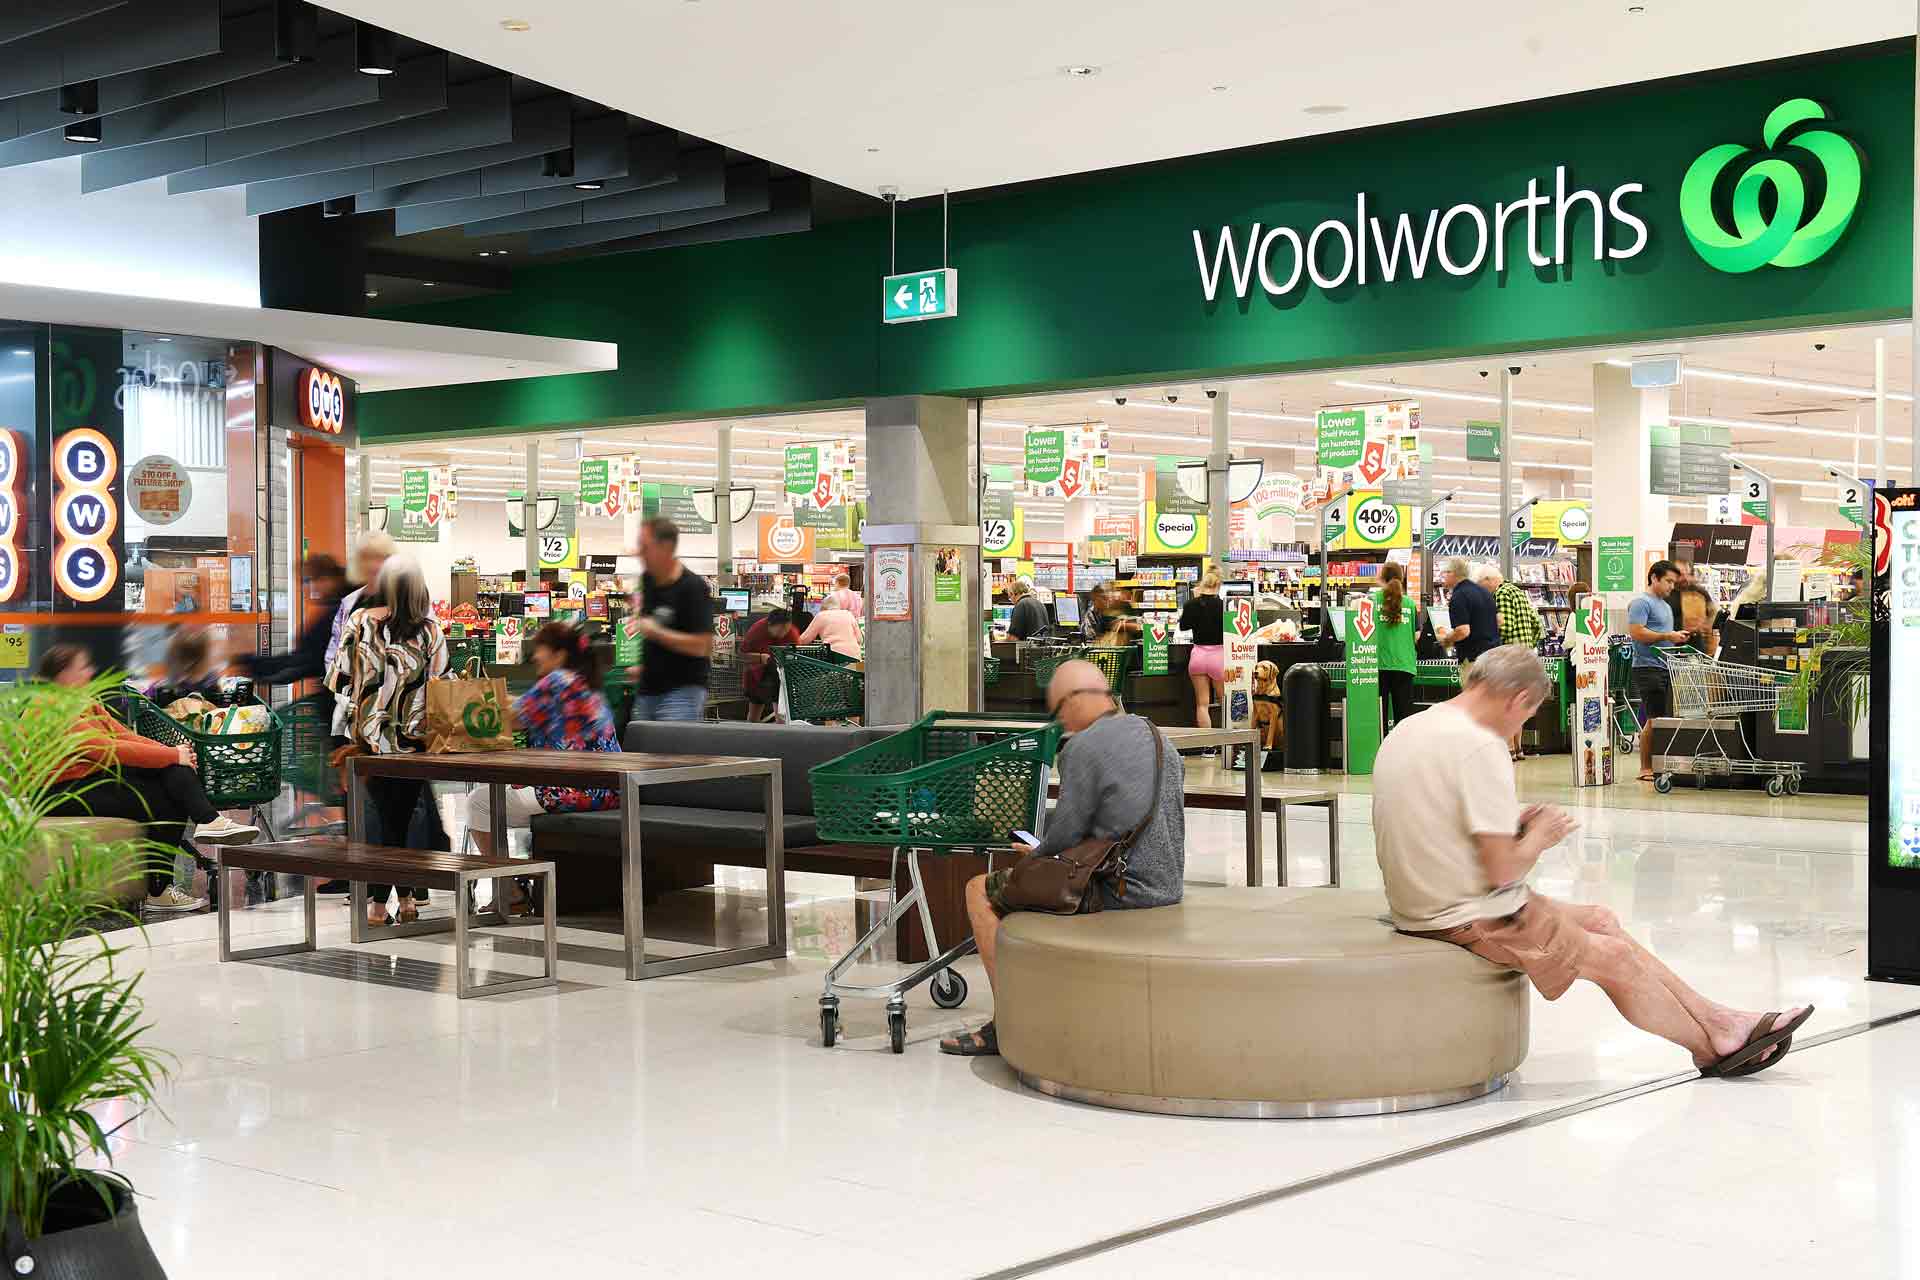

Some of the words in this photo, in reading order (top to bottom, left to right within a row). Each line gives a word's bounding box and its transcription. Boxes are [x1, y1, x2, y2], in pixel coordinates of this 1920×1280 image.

[1193, 166, 1648, 300] woolworths
[1321, 415, 1356, 429] Lower
[1321, 430, 1338, 438] Shelf
[1028, 436, 1056, 446] Lower
[1330, 439, 1360, 448] hundreds
[787, 450, 812, 461] Lower
[1329, 449, 1359, 459] products
[582, 464, 604, 474] Lower
[1749, 483, 1760, 498] 3
[1846, 489, 1857, 503] 2
[71, 450, 102, 580] BWS
[1330, 508, 1341, 522] 4
[1359, 508, 1396, 524] 40%
[1430, 512, 1439, 526] 5
[1158, 523, 1194, 533] Special
[1517, 516, 1526, 529] 6
[1562, 520, 1587, 528] Special
[984, 520, 1006, 538] 1/2
[1368, 525, 1386, 534] Off
[544, 536, 563, 552] 1/2
[544, 551, 561, 559] Price
[1231, 642, 1256, 653] Lower
[1583, 643, 1608, 656] Lower
[1351, 656, 1366, 664] Shelf
